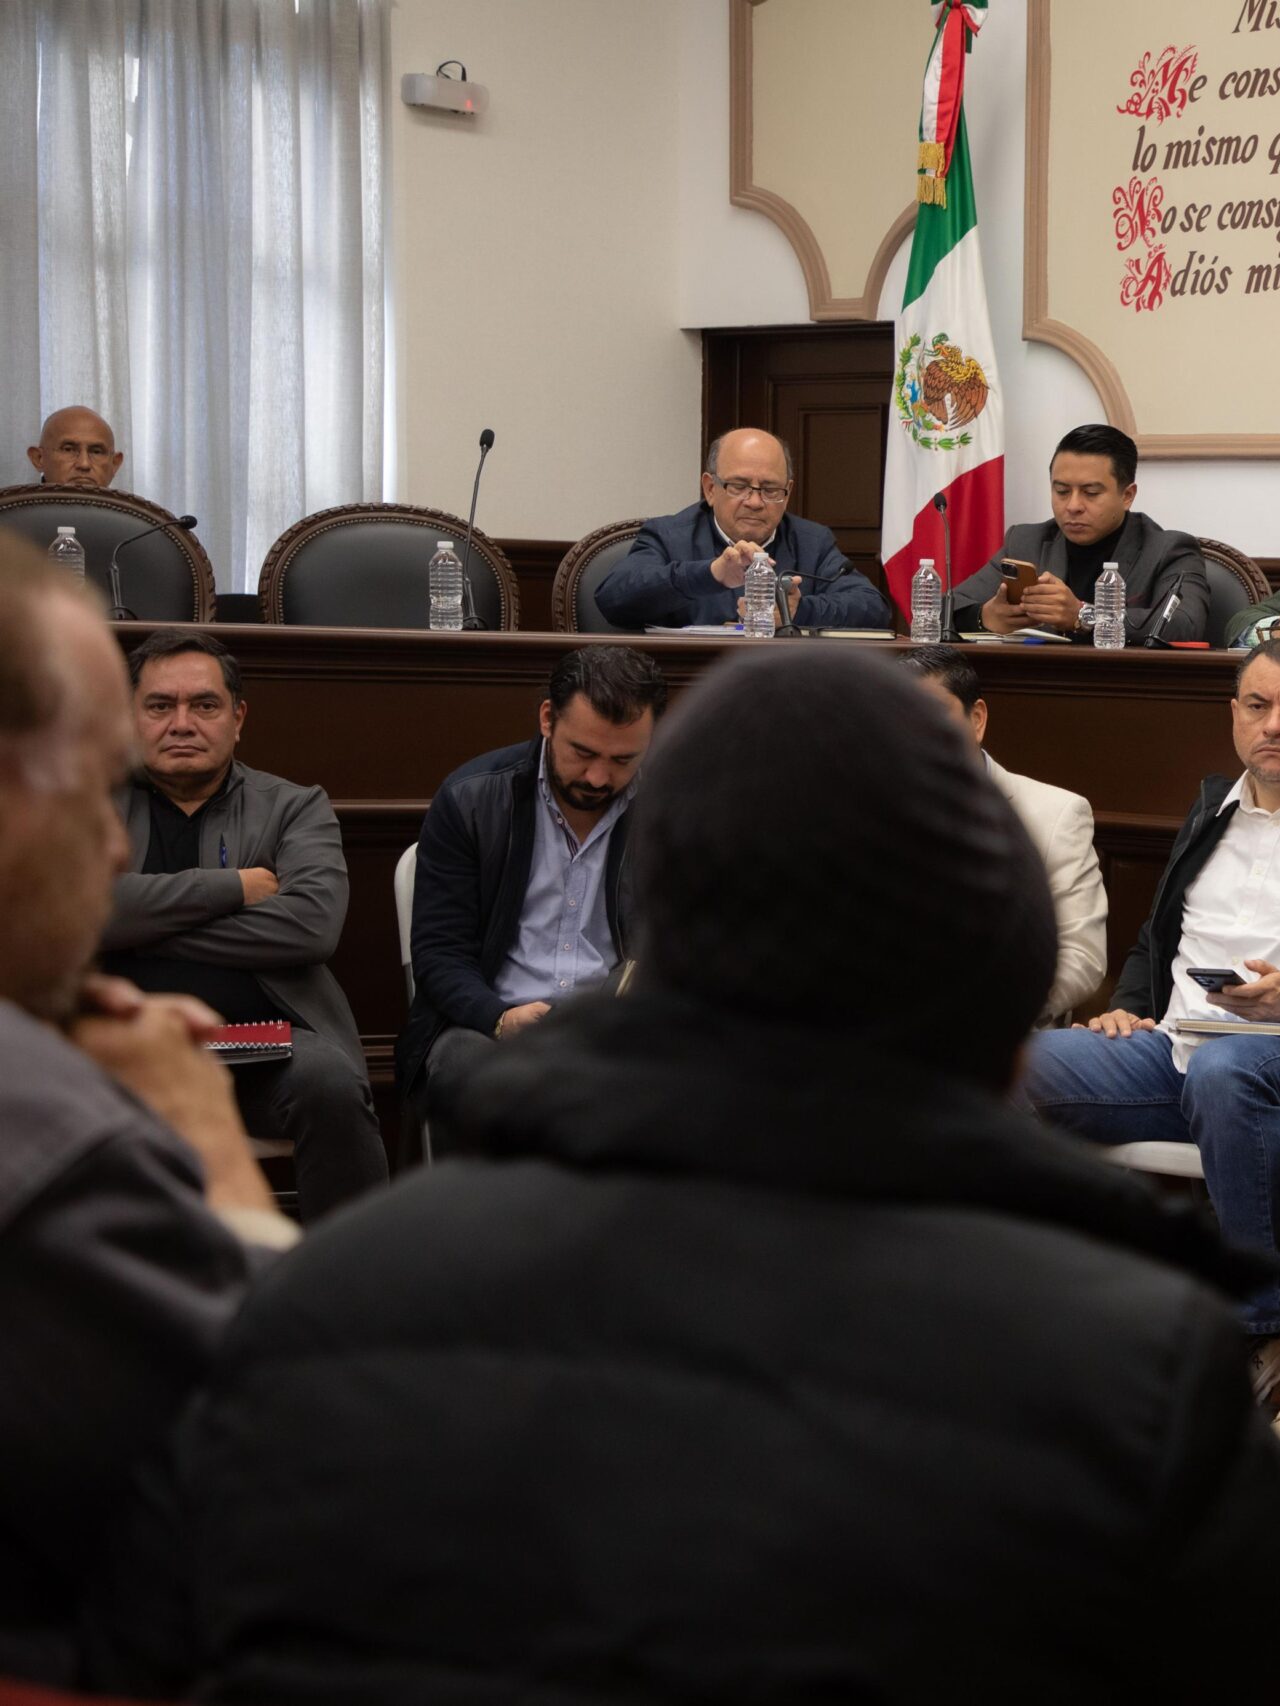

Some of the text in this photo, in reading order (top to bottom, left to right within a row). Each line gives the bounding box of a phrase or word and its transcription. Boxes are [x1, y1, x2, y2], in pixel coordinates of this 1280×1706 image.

[1131, 124, 1158, 173] lo
[1162, 124, 1259, 171] mismo
[1179, 202, 1212, 233] se
